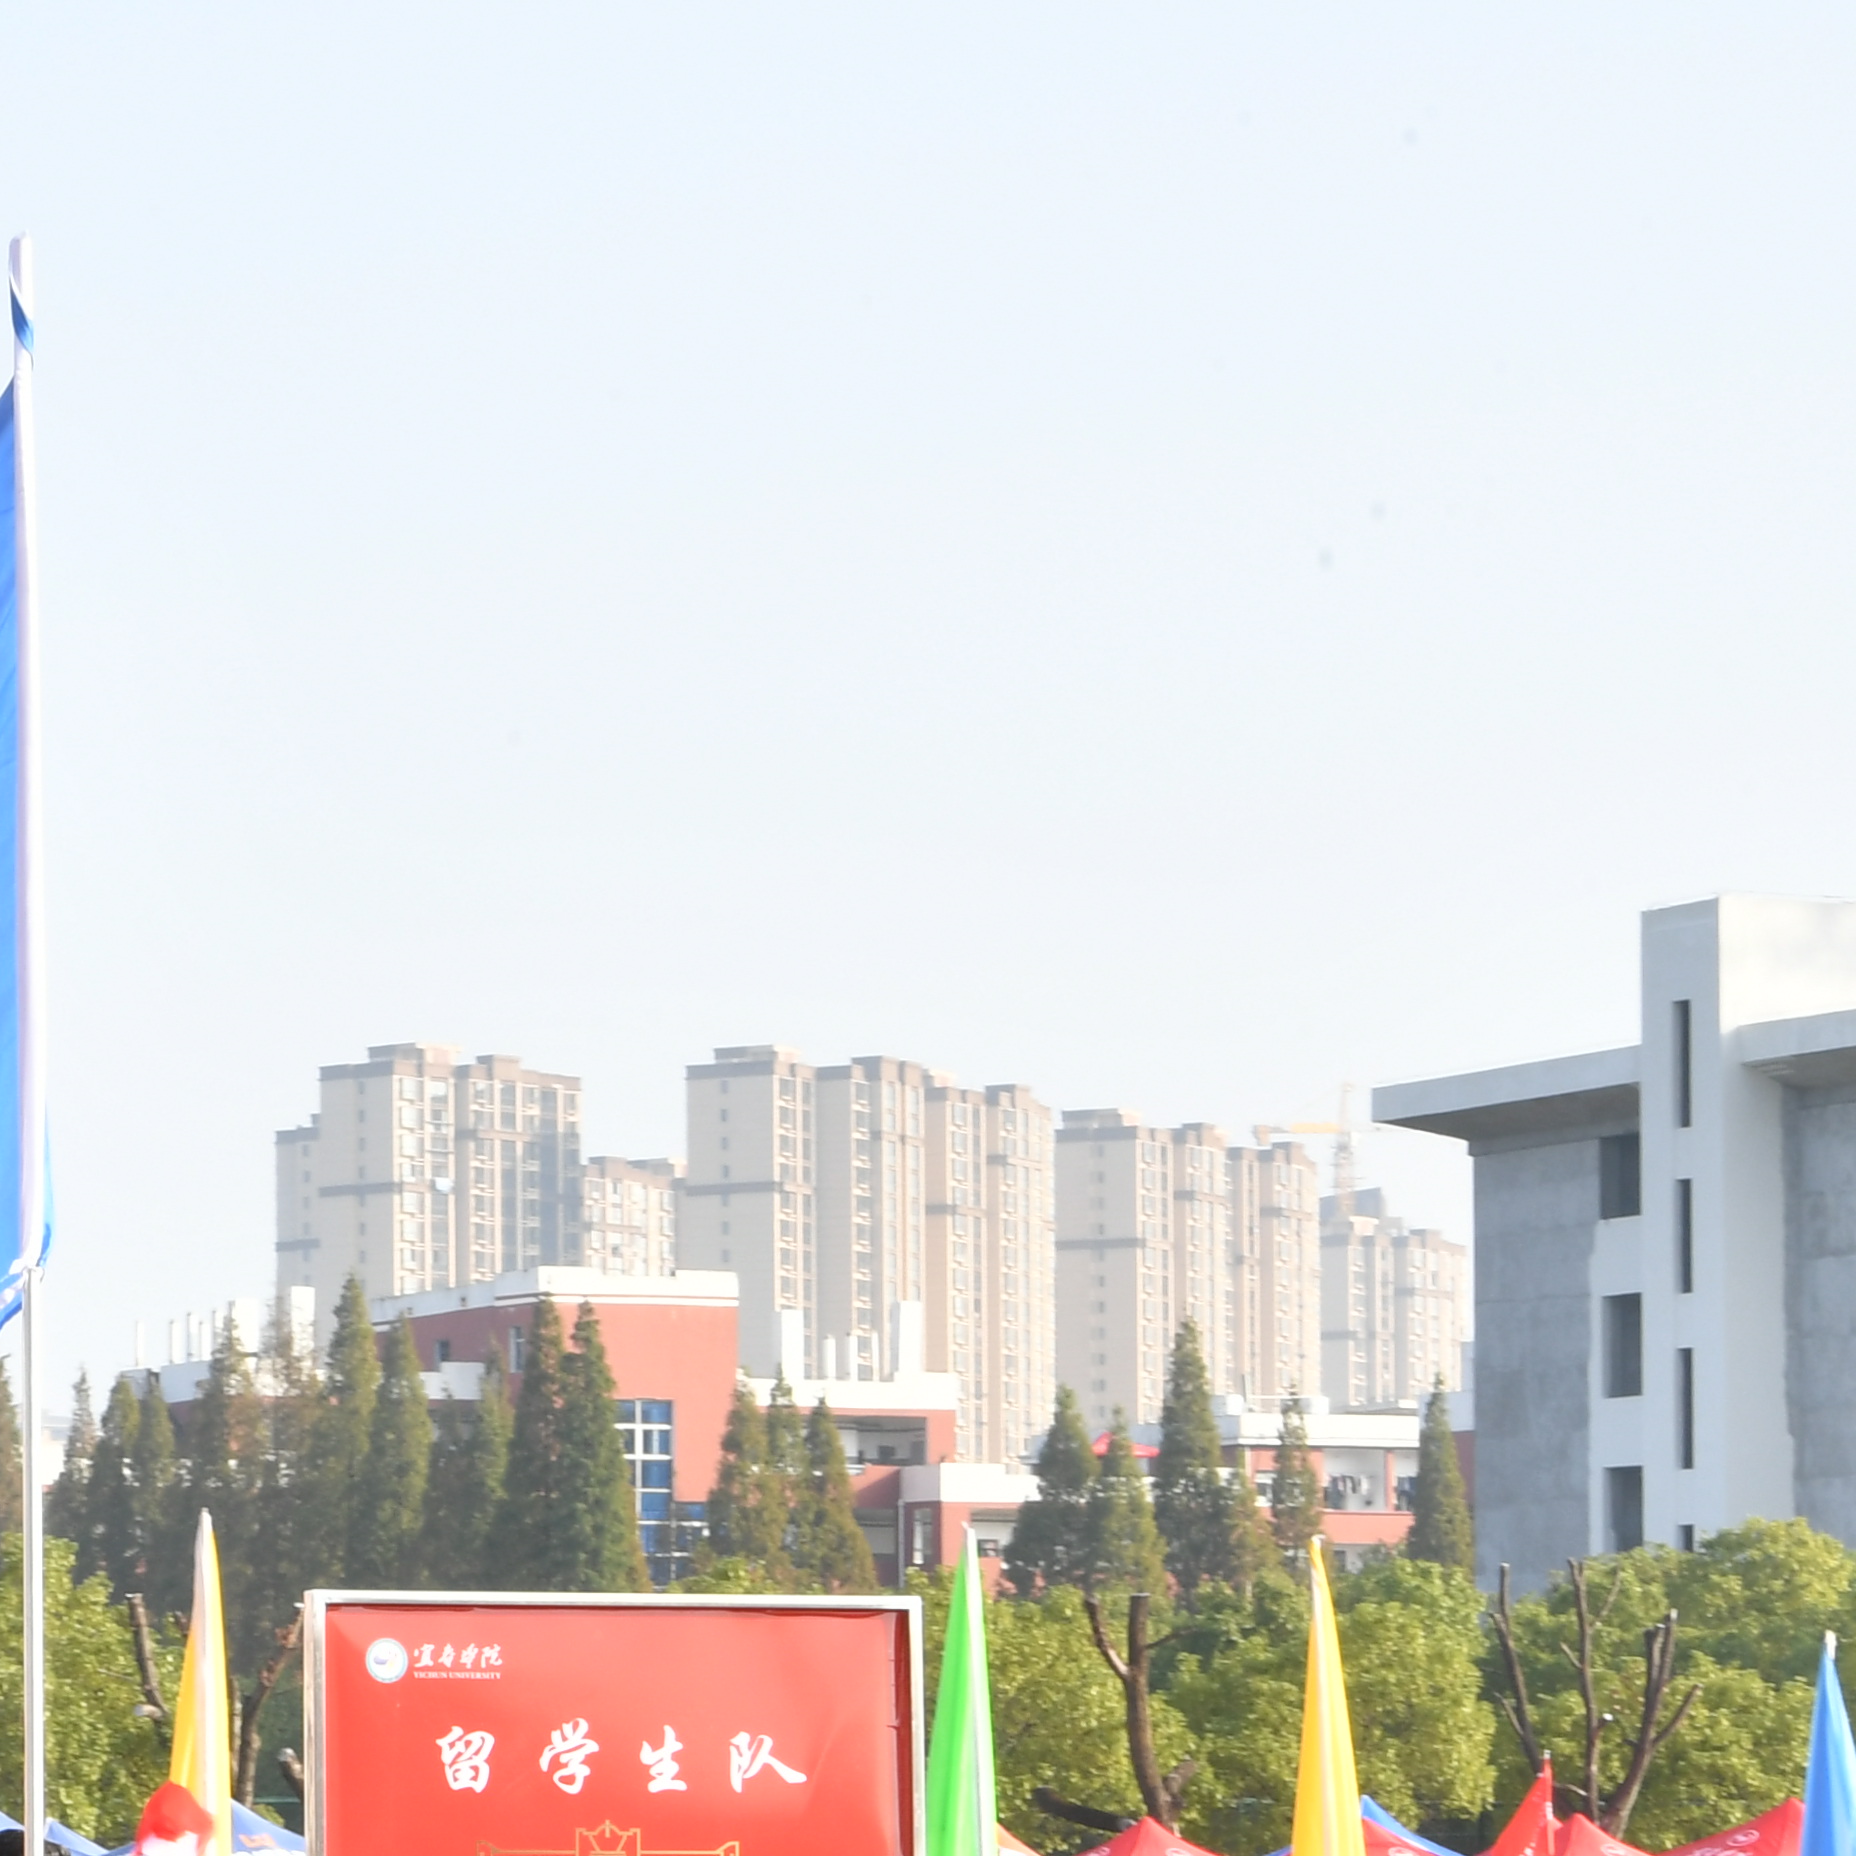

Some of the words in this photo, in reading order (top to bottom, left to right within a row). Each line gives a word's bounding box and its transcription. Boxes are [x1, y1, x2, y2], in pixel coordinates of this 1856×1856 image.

[413, 1670, 448, 1680] YICHUN
[449, 1671, 502, 1680] UNIVERSITY
[435, 1717, 807, 1794] 留学生队
